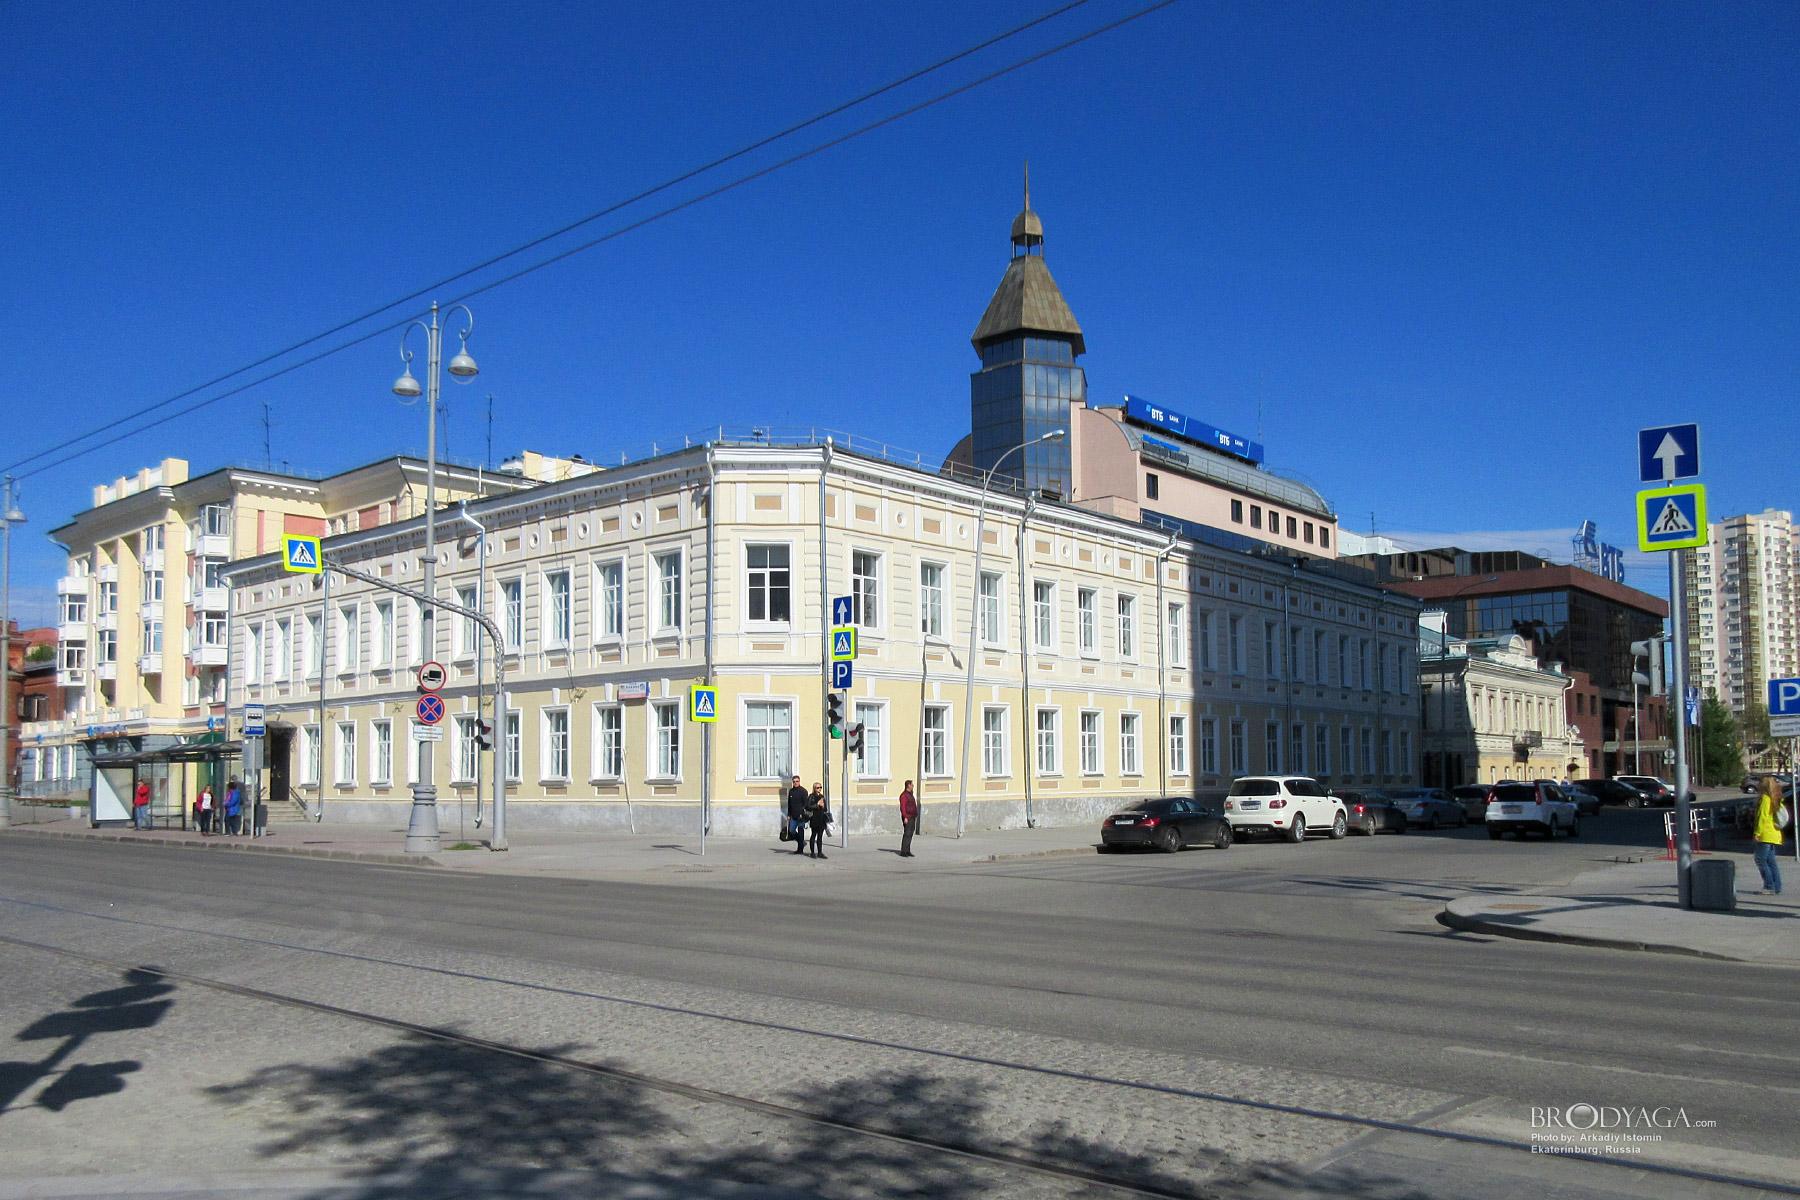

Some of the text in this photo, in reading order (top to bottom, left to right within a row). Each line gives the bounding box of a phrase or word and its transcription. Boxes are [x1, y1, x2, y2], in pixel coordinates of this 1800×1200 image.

[1151, 408, 1164, 422] ВТБ
[1219, 434, 1230, 446] ВТБ
[1599, 541, 1625, 584] ВТБ
[836, 663, 848, 686] P
[1778, 682, 1800, 712] P
